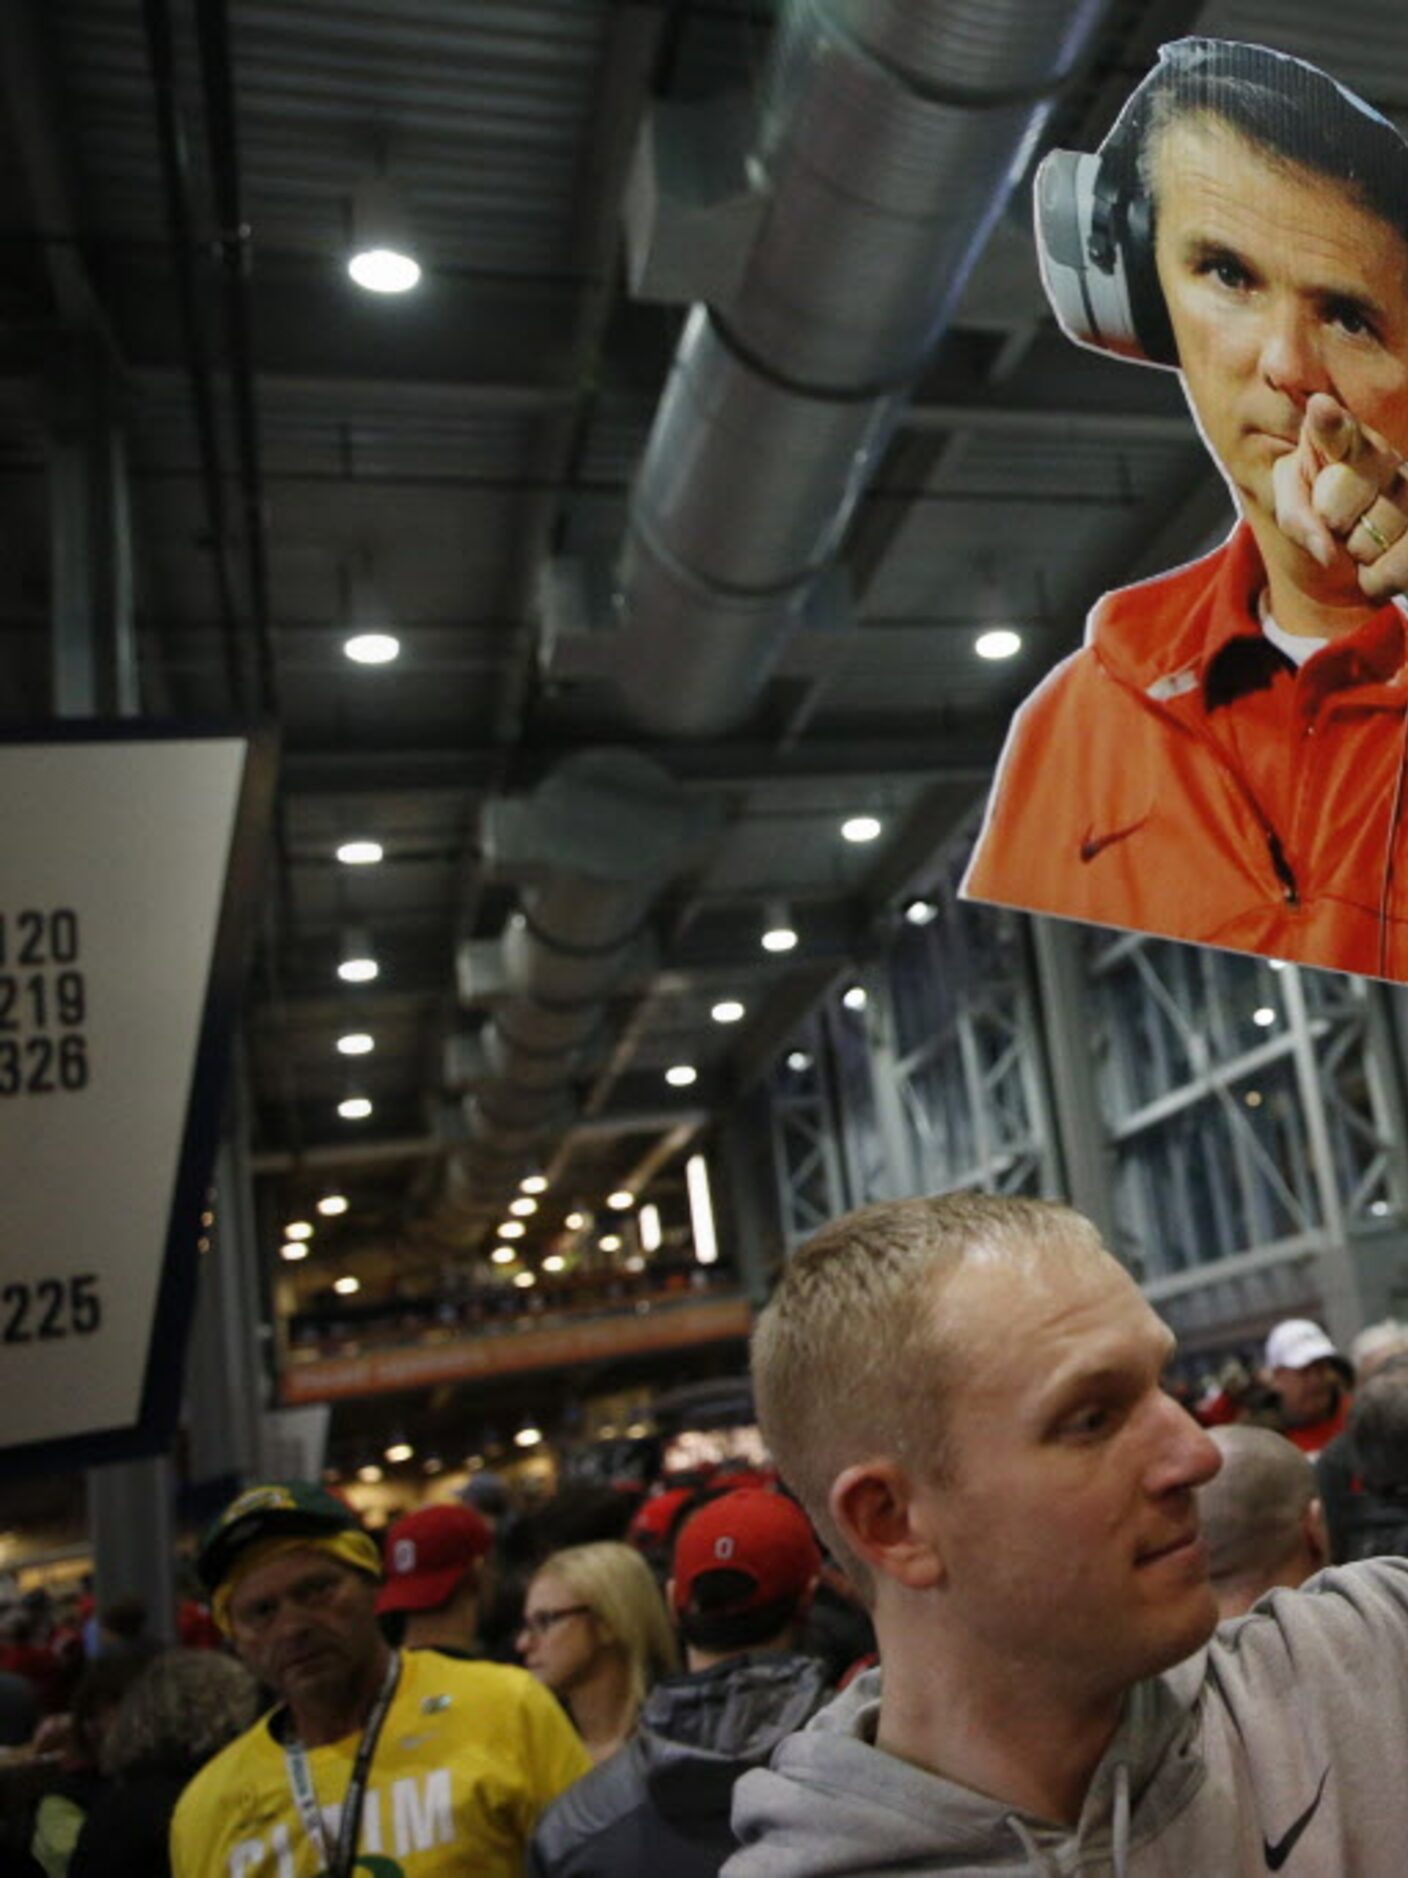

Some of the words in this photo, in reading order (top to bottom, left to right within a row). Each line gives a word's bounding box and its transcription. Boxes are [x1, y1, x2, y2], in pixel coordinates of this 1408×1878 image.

[0, 971, 86, 1030] 219
[0, 1034, 89, 1096] 326
[3, 1273, 102, 1343] 225
